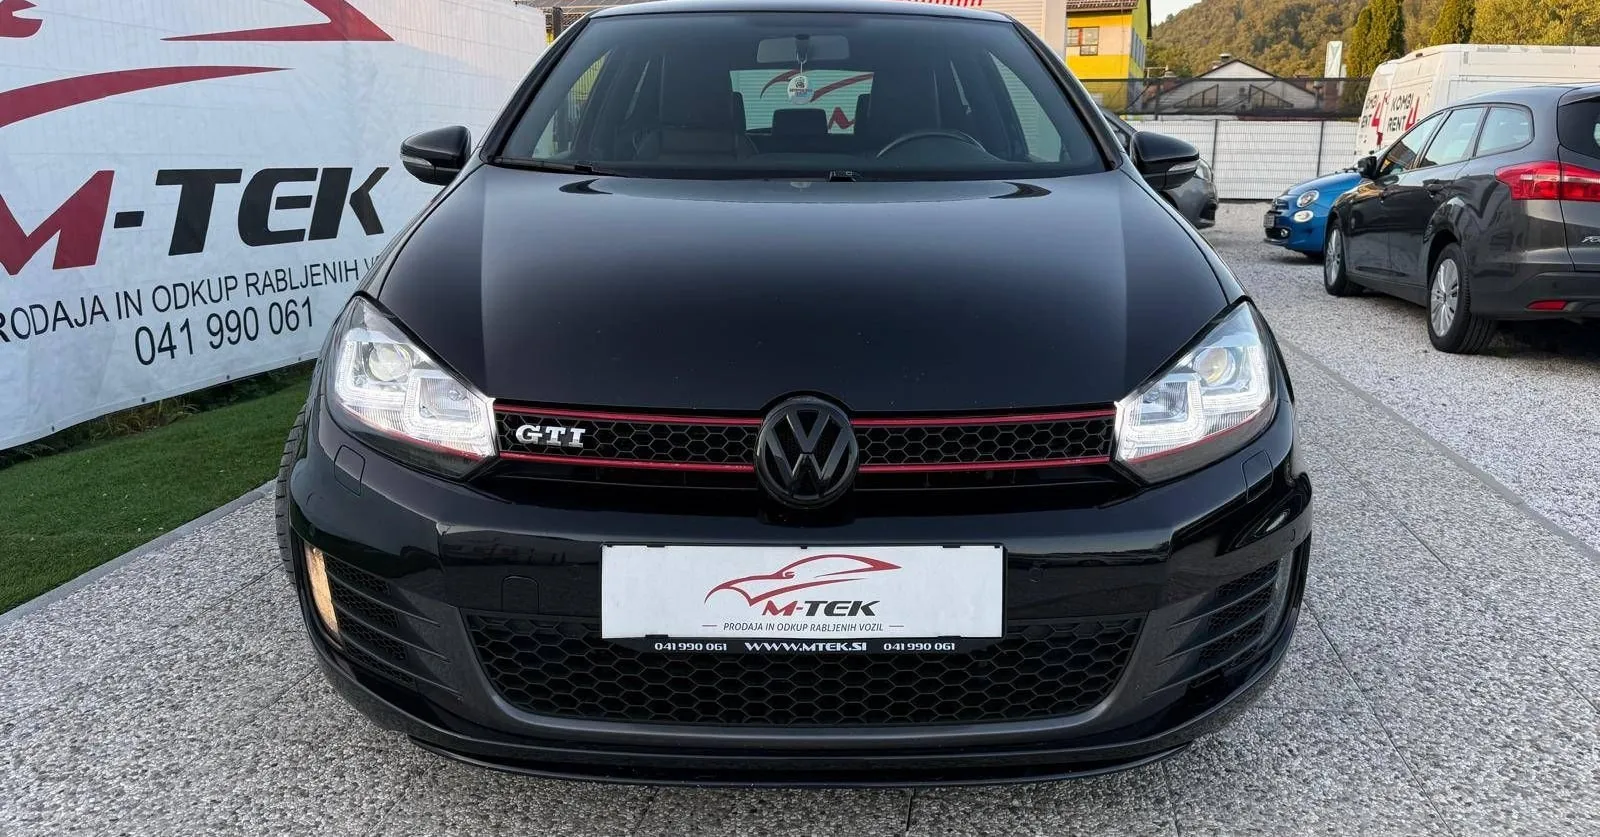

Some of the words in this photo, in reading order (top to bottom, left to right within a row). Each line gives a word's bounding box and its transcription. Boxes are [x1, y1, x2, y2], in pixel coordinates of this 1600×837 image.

[1391, 93, 1414, 110] KOMBI
[1387, 115, 1406, 132] RENT
[0, 166, 390, 276] M-TEK
[115, 288, 143, 320] IN
[151, 274, 238, 313] ODKUP
[245, 259, 359, 297] RABLJENIH
[134, 317, 194, 366] 041
[206, 306, 259, 350] 990
[268, 296, 313, 335] 061
[515, 423, 587, 449] GTI
[761, 599, 880, 617] M-TEK
[723, 622, 763, 632] PRODAJA
[765, 622, 775, 632] IN
[777, 622, 808, 632] ODKUP
[810, 623, 856, 633] RABLJENIH
[859, 623, 884, 633] VOZIL
[654, 642, 677, 651] 041
[678, 642, 703, 651] 990
[706, 642, 728, 651] 061
[744, 642, 867, 652] WWW.MTEK.SI
[883, 642, 905, 651] 041
[907, 642, 932, 651] 990
[934, 642, 956, 651] 061
